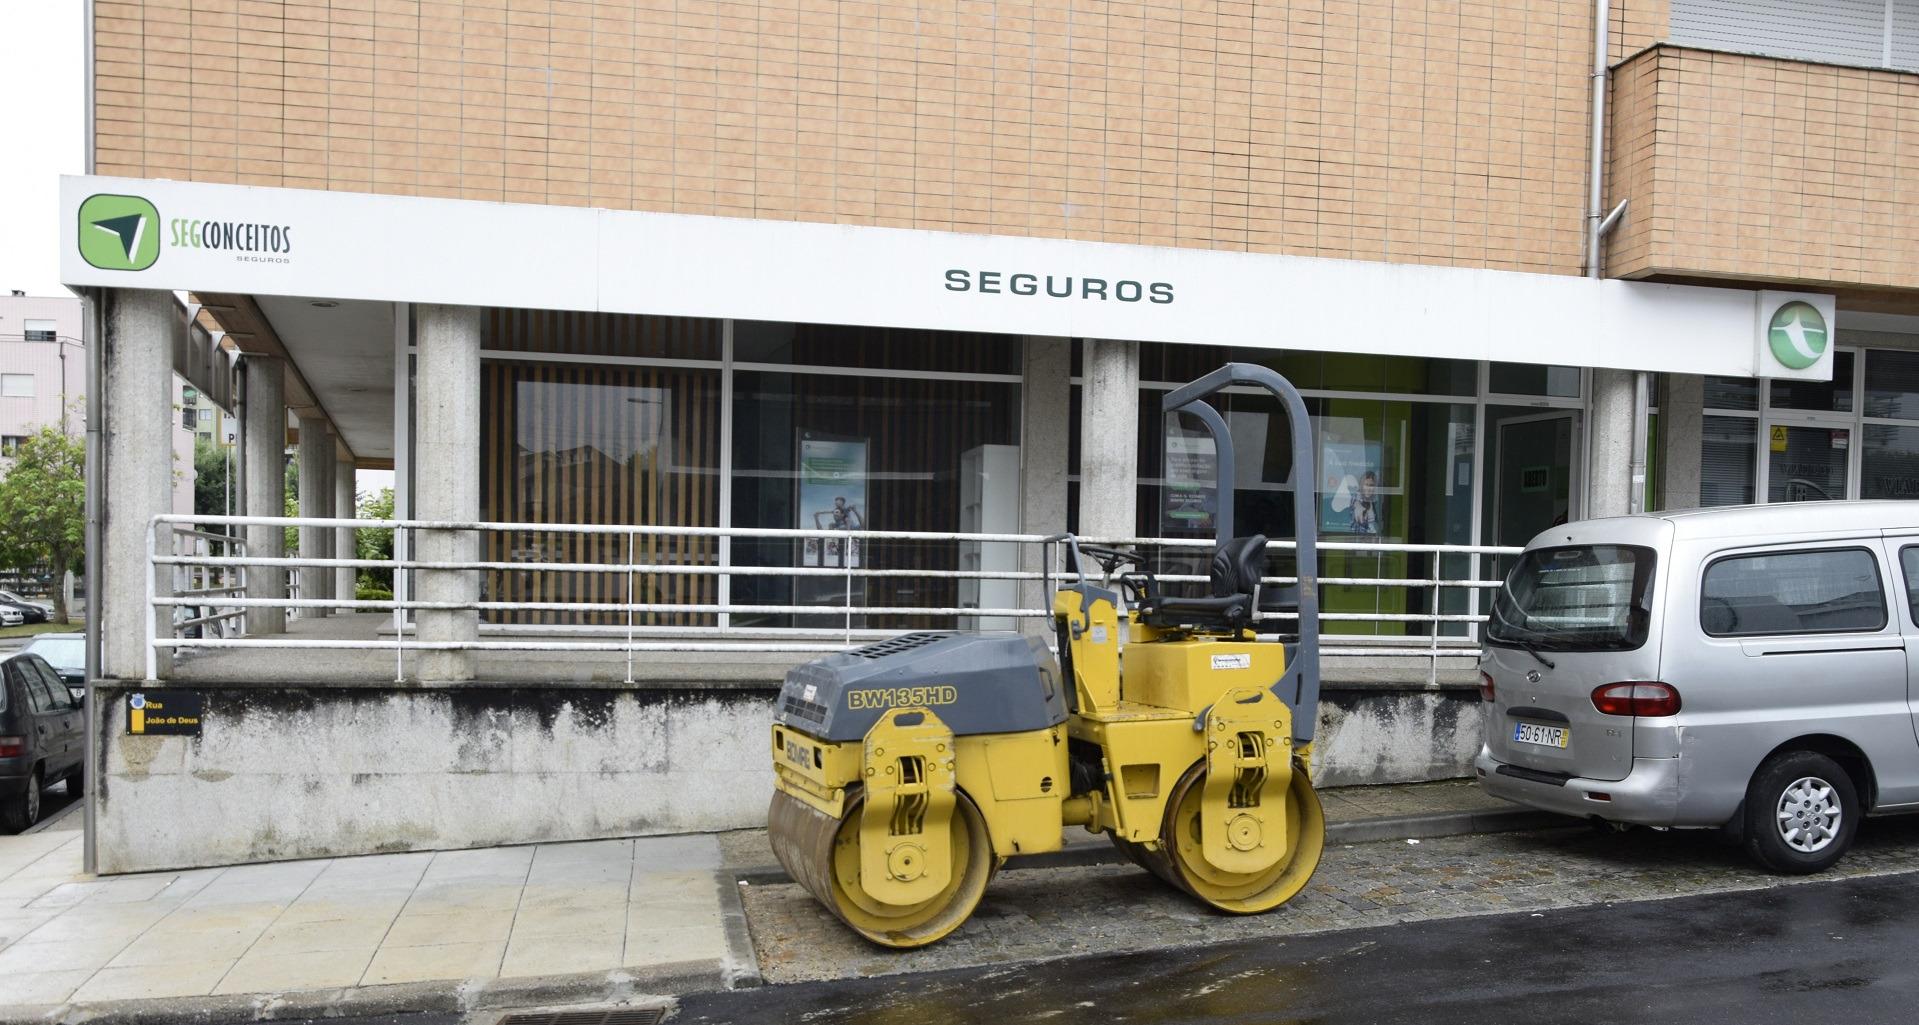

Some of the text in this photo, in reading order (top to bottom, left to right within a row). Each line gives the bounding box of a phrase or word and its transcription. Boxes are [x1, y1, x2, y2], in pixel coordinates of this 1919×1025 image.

[170, 217, 291, 254] SEGCONCEITOS
[236, 255, 291, 264] SEGUROS
[945, 269, 1174, 304] SEGUROS
[145, 701, 163, 709] Rua
[847, 685, 957, 710] BW135HD
[145, 716, 199, 724] João de Deus
